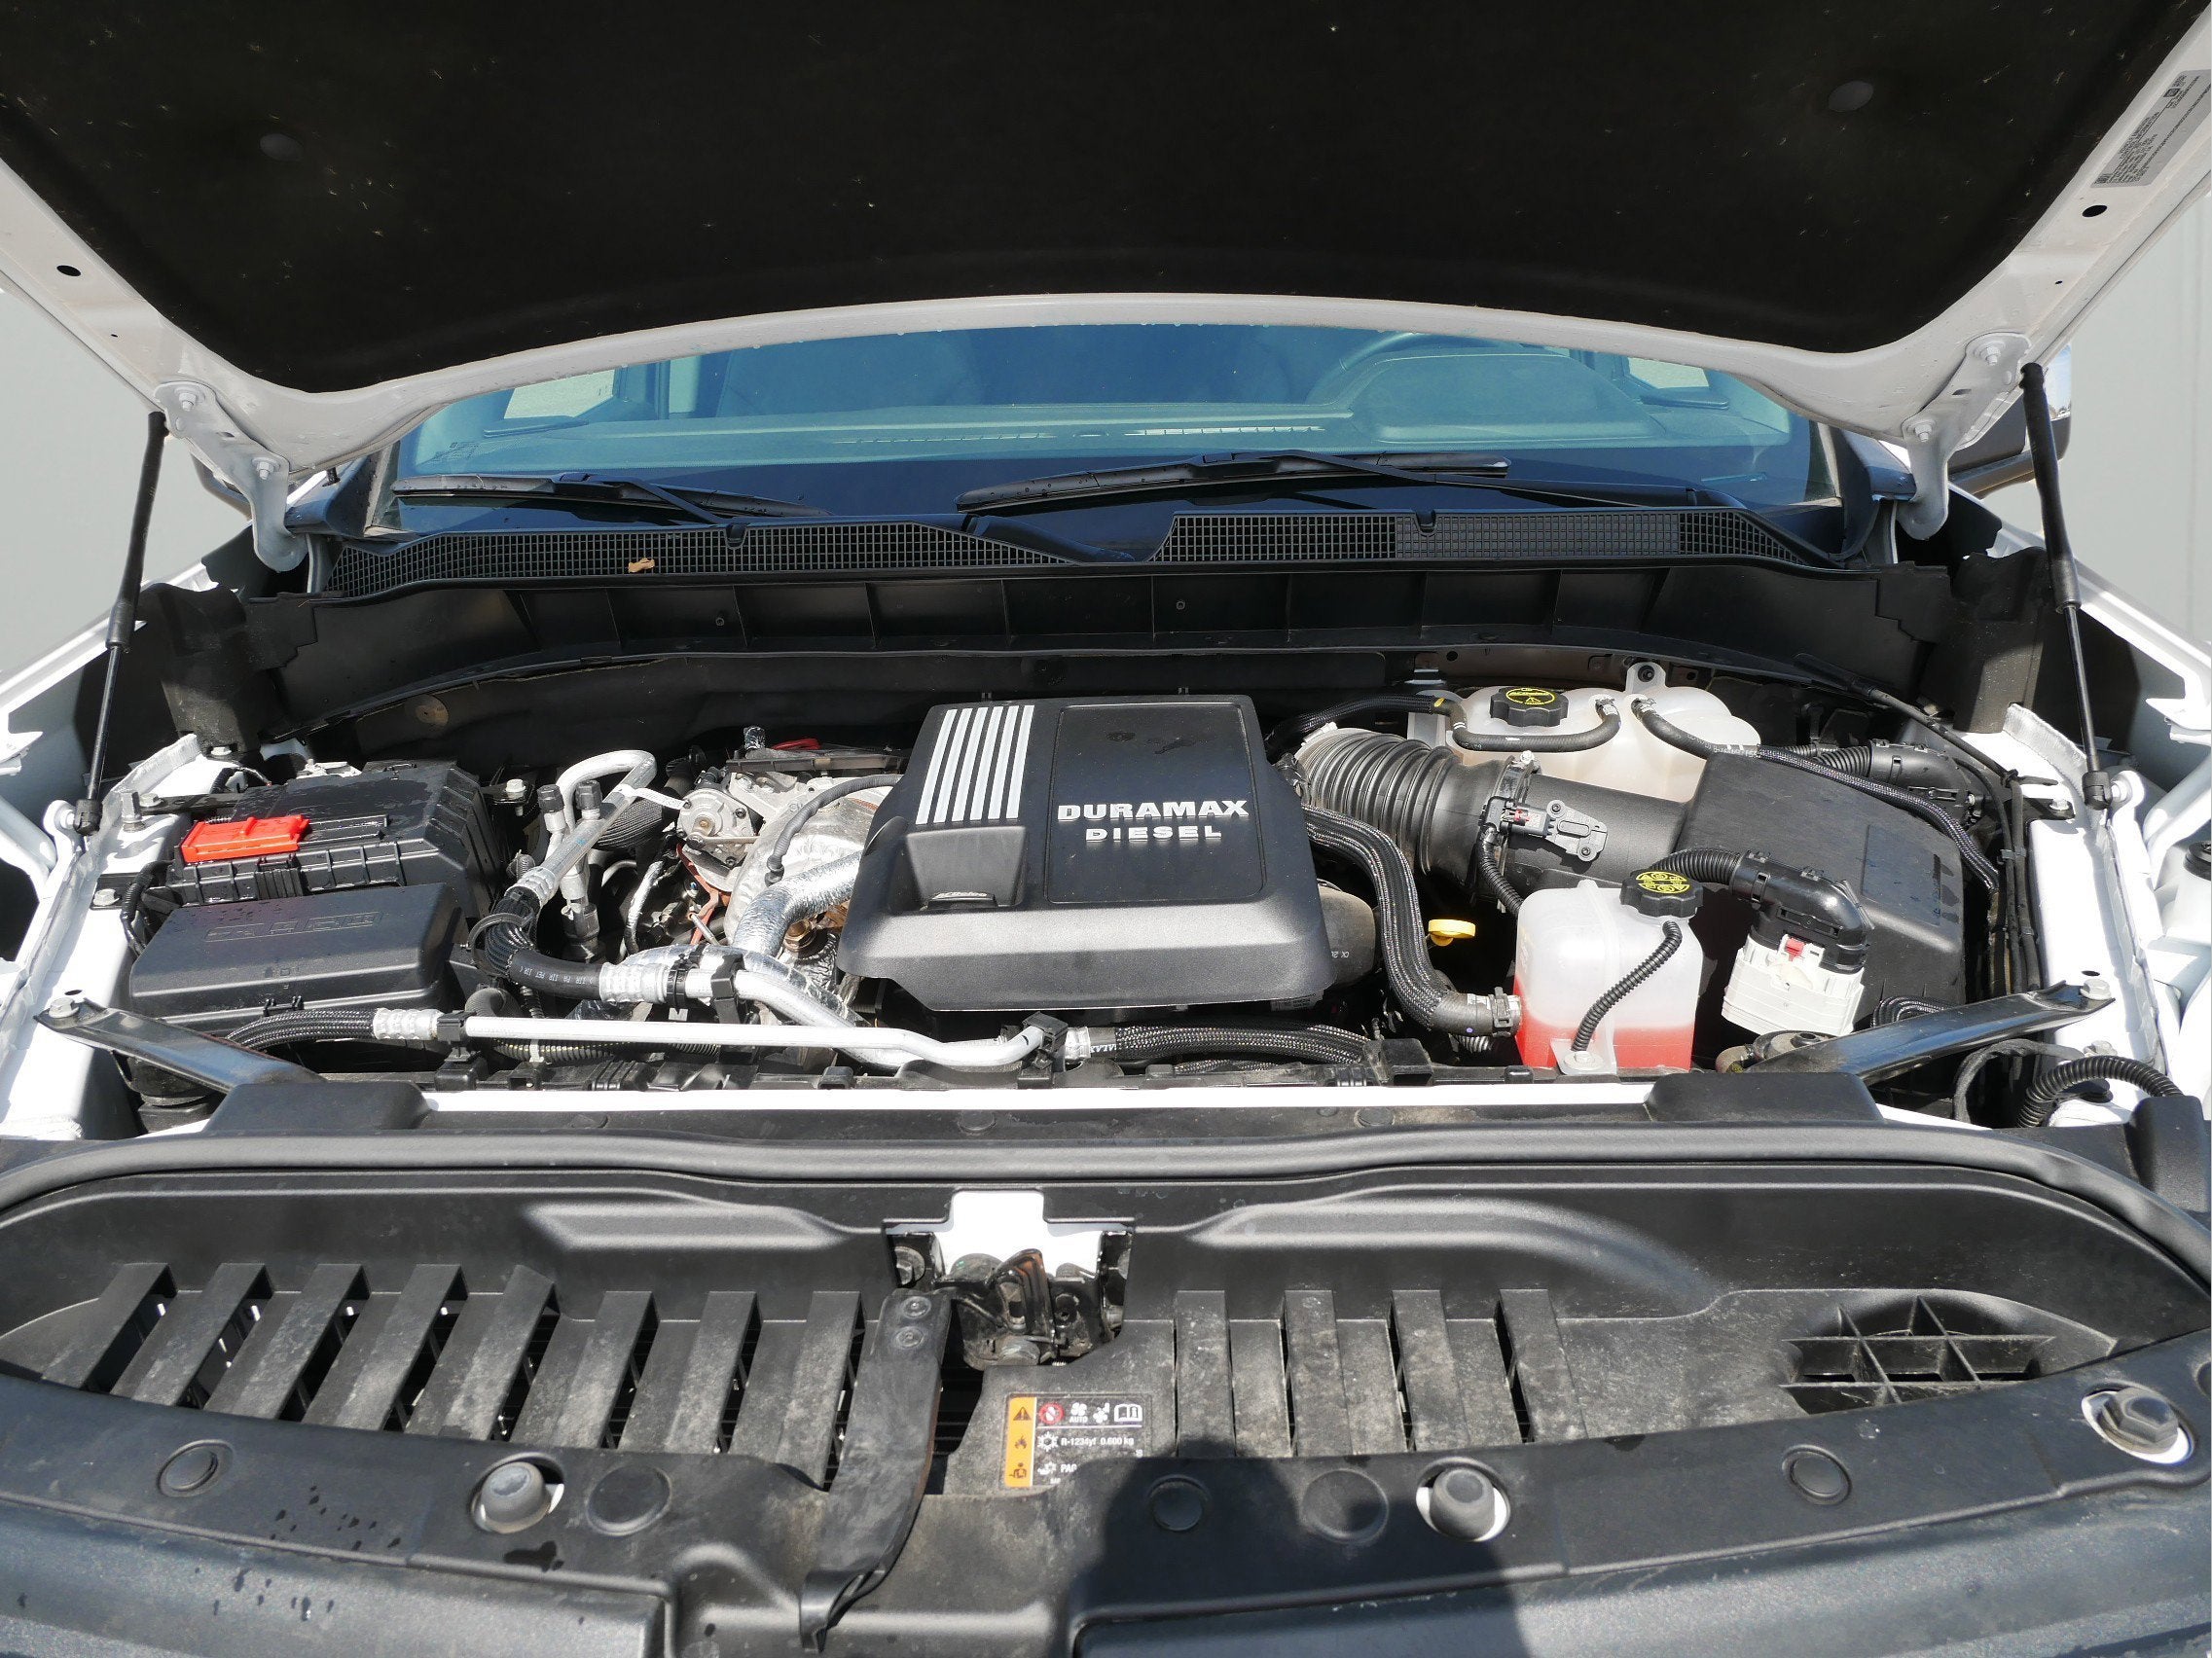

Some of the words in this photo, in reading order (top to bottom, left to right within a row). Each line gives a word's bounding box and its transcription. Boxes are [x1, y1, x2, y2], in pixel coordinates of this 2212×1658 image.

[1057, 800, 1250, 821] DURAMAX
[1085, 825, 1222, 842] DIESEL
[1061, 1437, 1097, 1448] R-1234yf
[1123, 1437, 1135, 1447] kg
